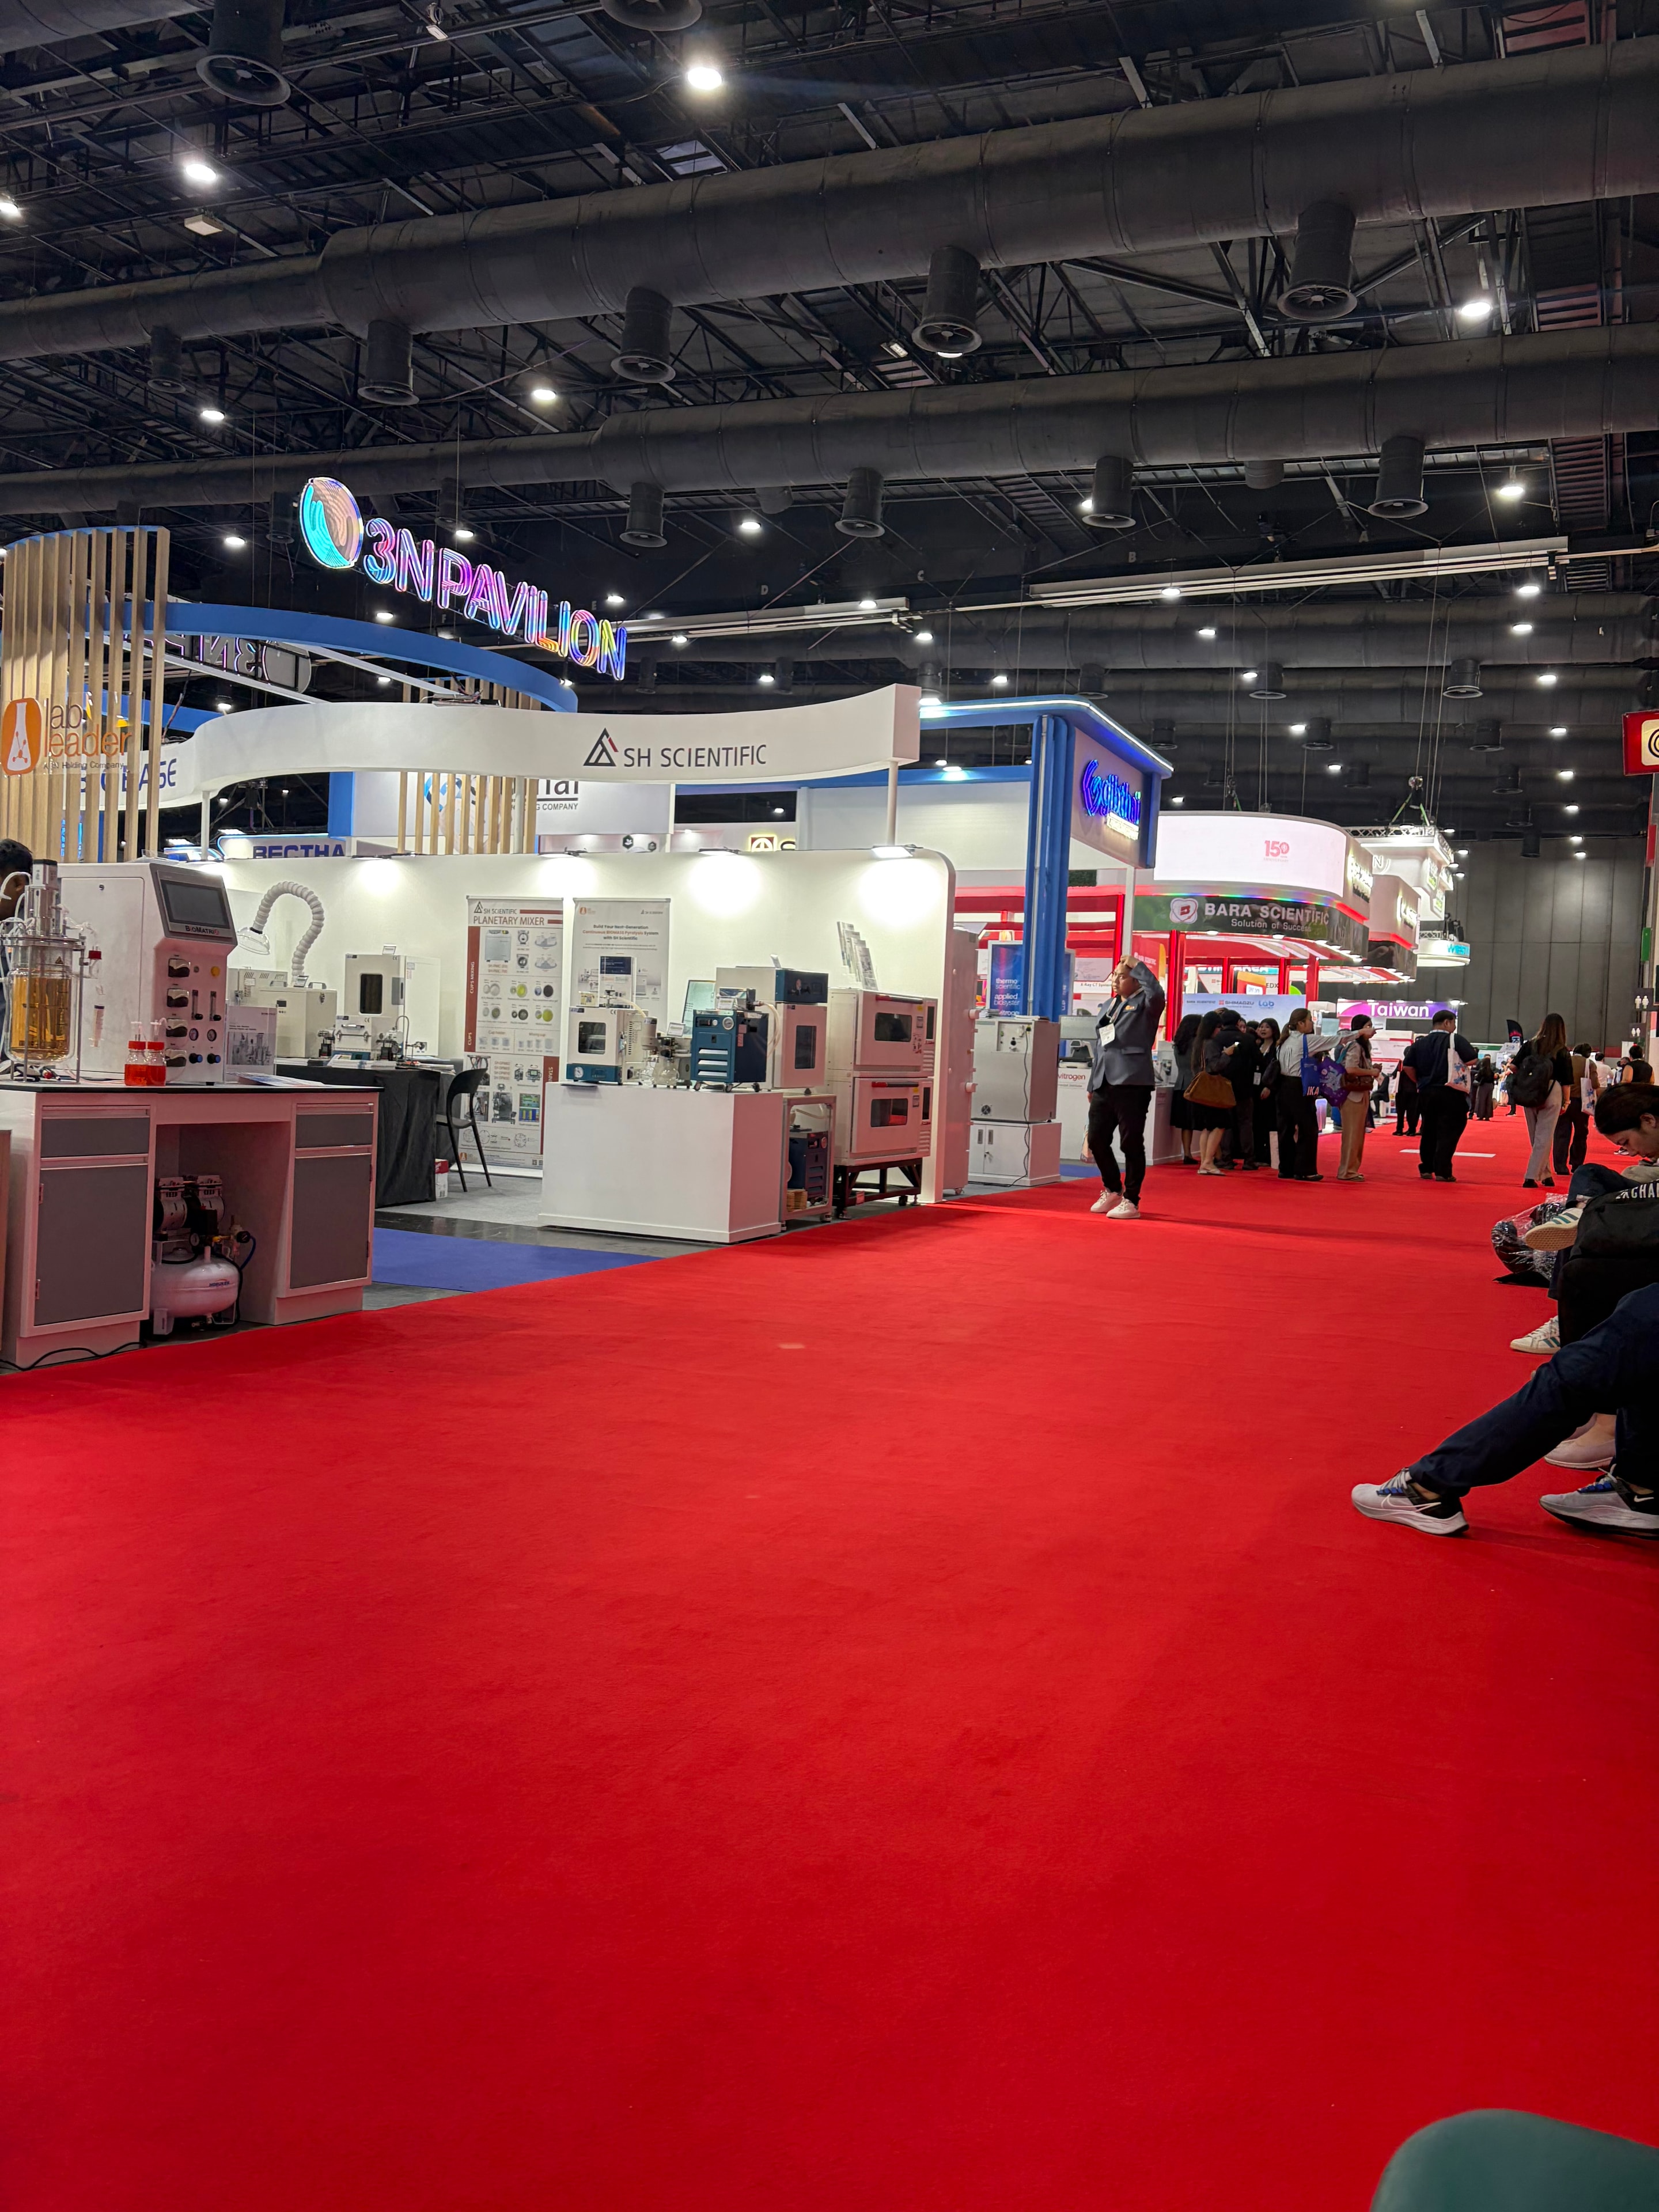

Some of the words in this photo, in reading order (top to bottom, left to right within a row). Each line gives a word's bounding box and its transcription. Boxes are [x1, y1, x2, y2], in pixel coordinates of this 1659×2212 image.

[1359, 531, 1369, 543] A
[1128, 551, 1137, 563] B
[917, 570, 924, 581] C
[761, 585, 768, 595] D
[363, 518, 434, 602] 3N
[437, 547, 628, 681] PAVILION
[592, 601, 597, 610] E
[46, 698, 84, 729] lab
[44, 724, 132, 757] leader
[624, 748, 651, 767] SH
[661, 744, 767, 767] SCIENTIFIC
[62, 761, 88, 771] Holding
[90, 761, 124, 770] Company
[1264, 840, 1290, 857] 150
[1205, 903, 1252, 918] BARA
[1260, 905, 1330, 926] SCIENTIFIC
[474, 916, 518, 925] PLANETARY
[520, 917, 544, 926] MIXER
[1231, 919, 1267, 929] Solution
[1271, 921, 1280, 929] of
[1283, 922, 1312, 932] Success
[1368, 1002, 1429, 1017] Taiwan
[1307, 1086, 1319, 1096] IKA
